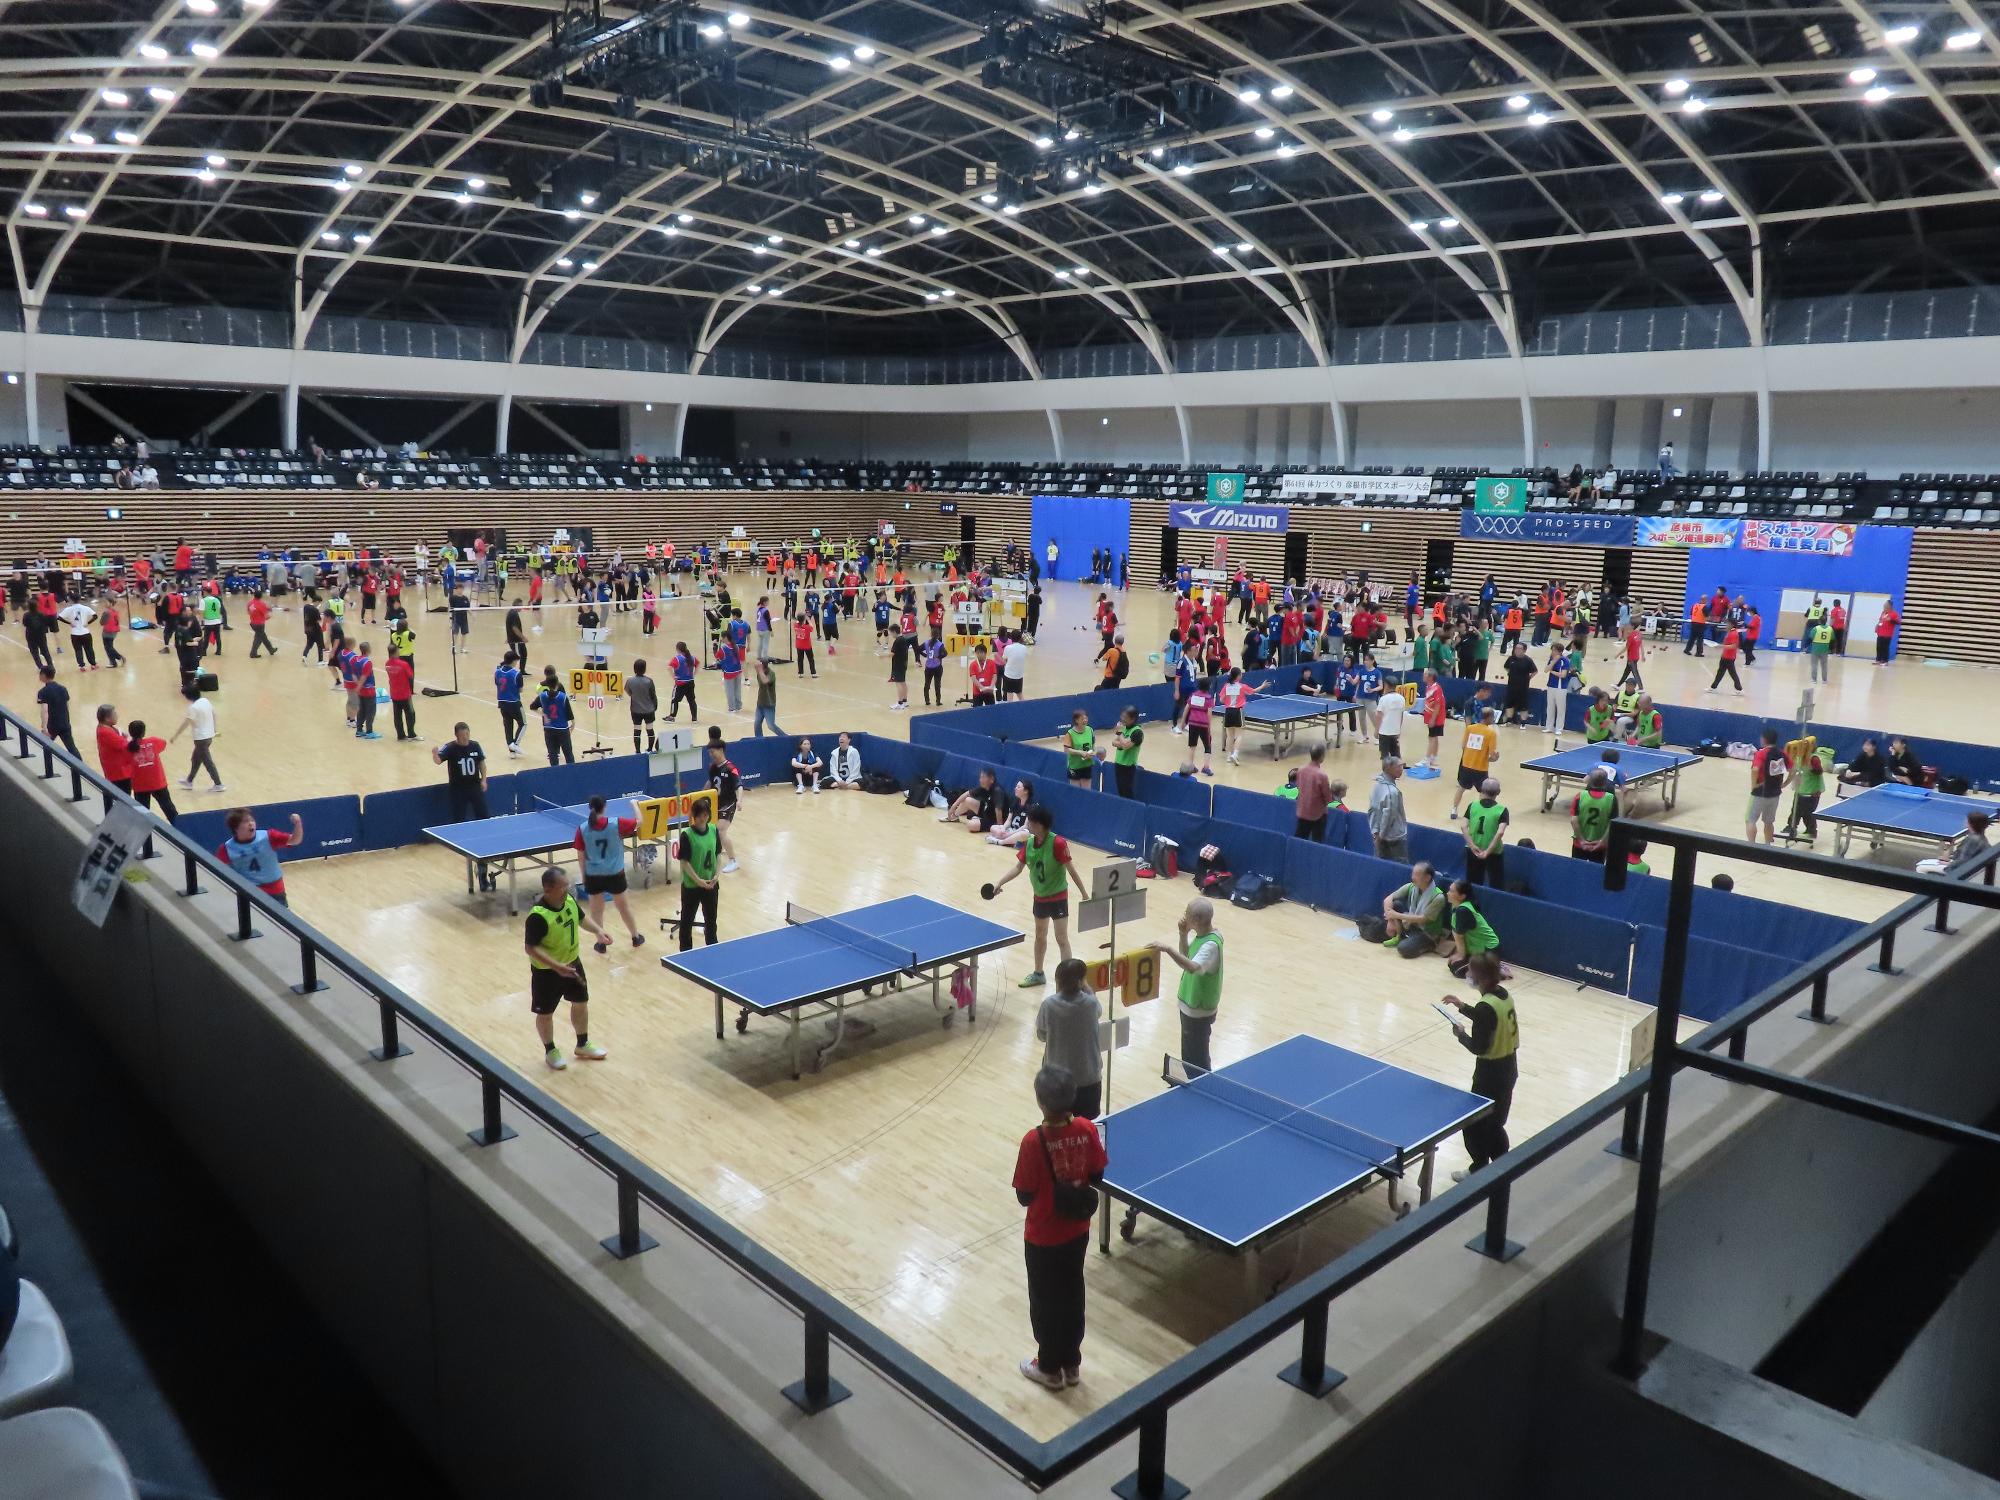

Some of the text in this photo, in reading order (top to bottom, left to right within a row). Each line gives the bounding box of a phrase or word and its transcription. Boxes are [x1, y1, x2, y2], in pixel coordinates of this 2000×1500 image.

[1536, 518, 1612, 529] PRO-SEED
[1760, 522, 1818, 536] スポーツ
[1768, 536, 1830, 552] 推進委員
[212, 602, 216, 612] 4
[882, 610, 887, 619] 5
[966, 604, 971, 612] 6
[592, 632, 597, 640] 7
[1821, 632, 1826, 640] 6
[1402, 646, 1407, 656] 4
[574, 672, 583, 690] 8
[588, 672, 593, 682] 0
[596, 672, 602, 683] 0
[605, 674, 618, 692] 12
[588, 698, 594, 708] 0
[597, 698, 603, 709] 0
[1408, 686, 1414, 706] 0
[1622, 700, 1629, 708] 5
[672, 734, 678, 749] 1
[458, 757, 476, 776] 10
[838, 762, 850, 778] 5
[668, 799, 677, 816] 0
[682, 797, 690, 814] 0
[646, 804, 660, 834] 7
[1587, 807, 1600, 825] 2
[1477, 816, 1486, 834] 1
[595, 838, 608, 859] 7
[704, 850, 712, 870] 4
[1108, 869, 1119, 892] 2
[1098, 964, 1108, 990] 0
[1115, 960, 1126, 984] 0
[1136, 957, 1153, 997] 8
[1066, 1135, 1089, 1147] TEAM
